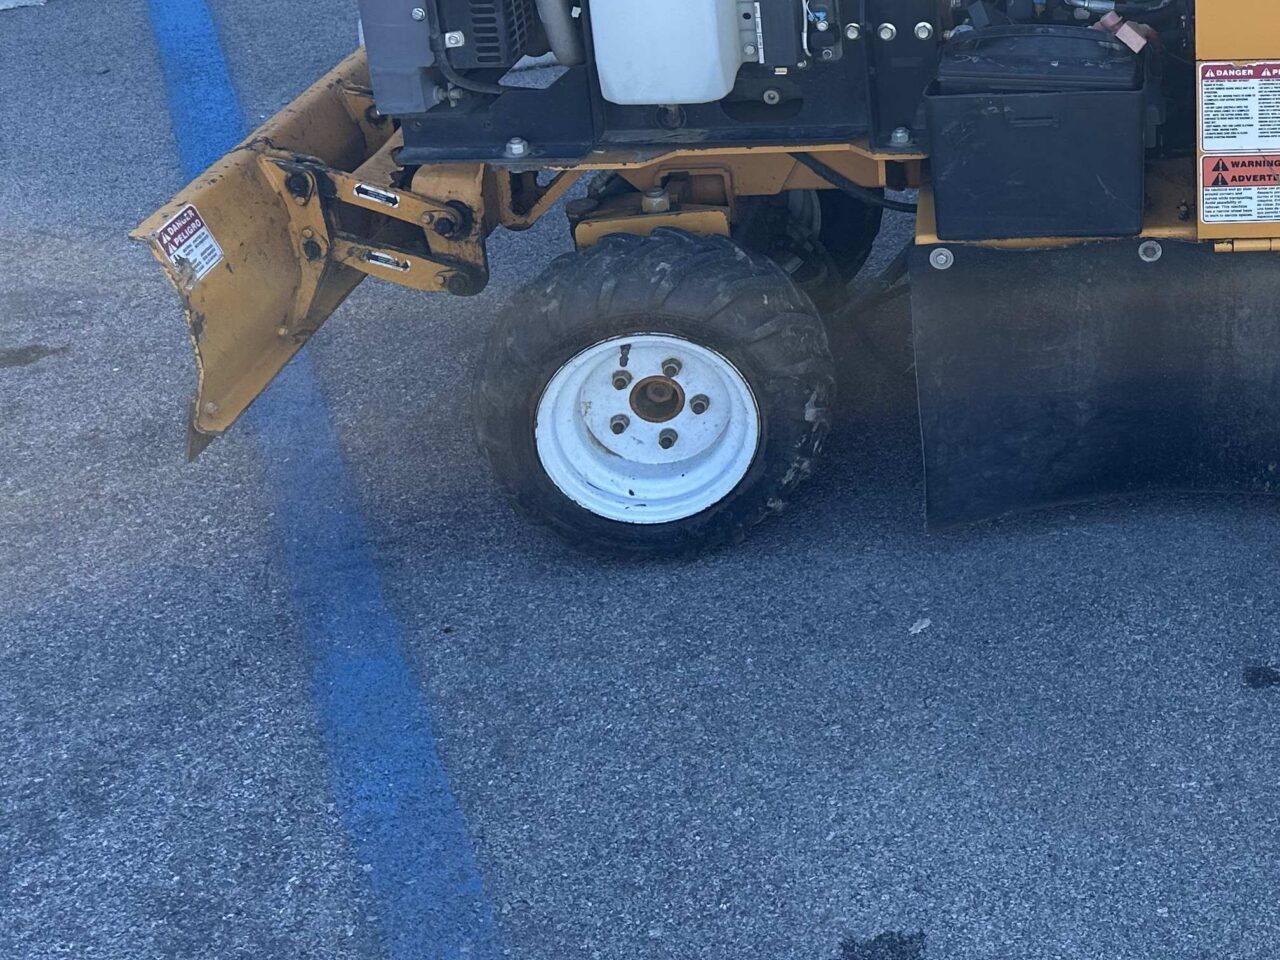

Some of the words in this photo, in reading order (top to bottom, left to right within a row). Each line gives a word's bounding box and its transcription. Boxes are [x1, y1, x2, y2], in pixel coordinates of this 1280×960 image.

[1231, 160, 1280, 168] WARNING
[167, 210, 195, 236] DANGER
[174, 219, 201, 246] PELIGRO
